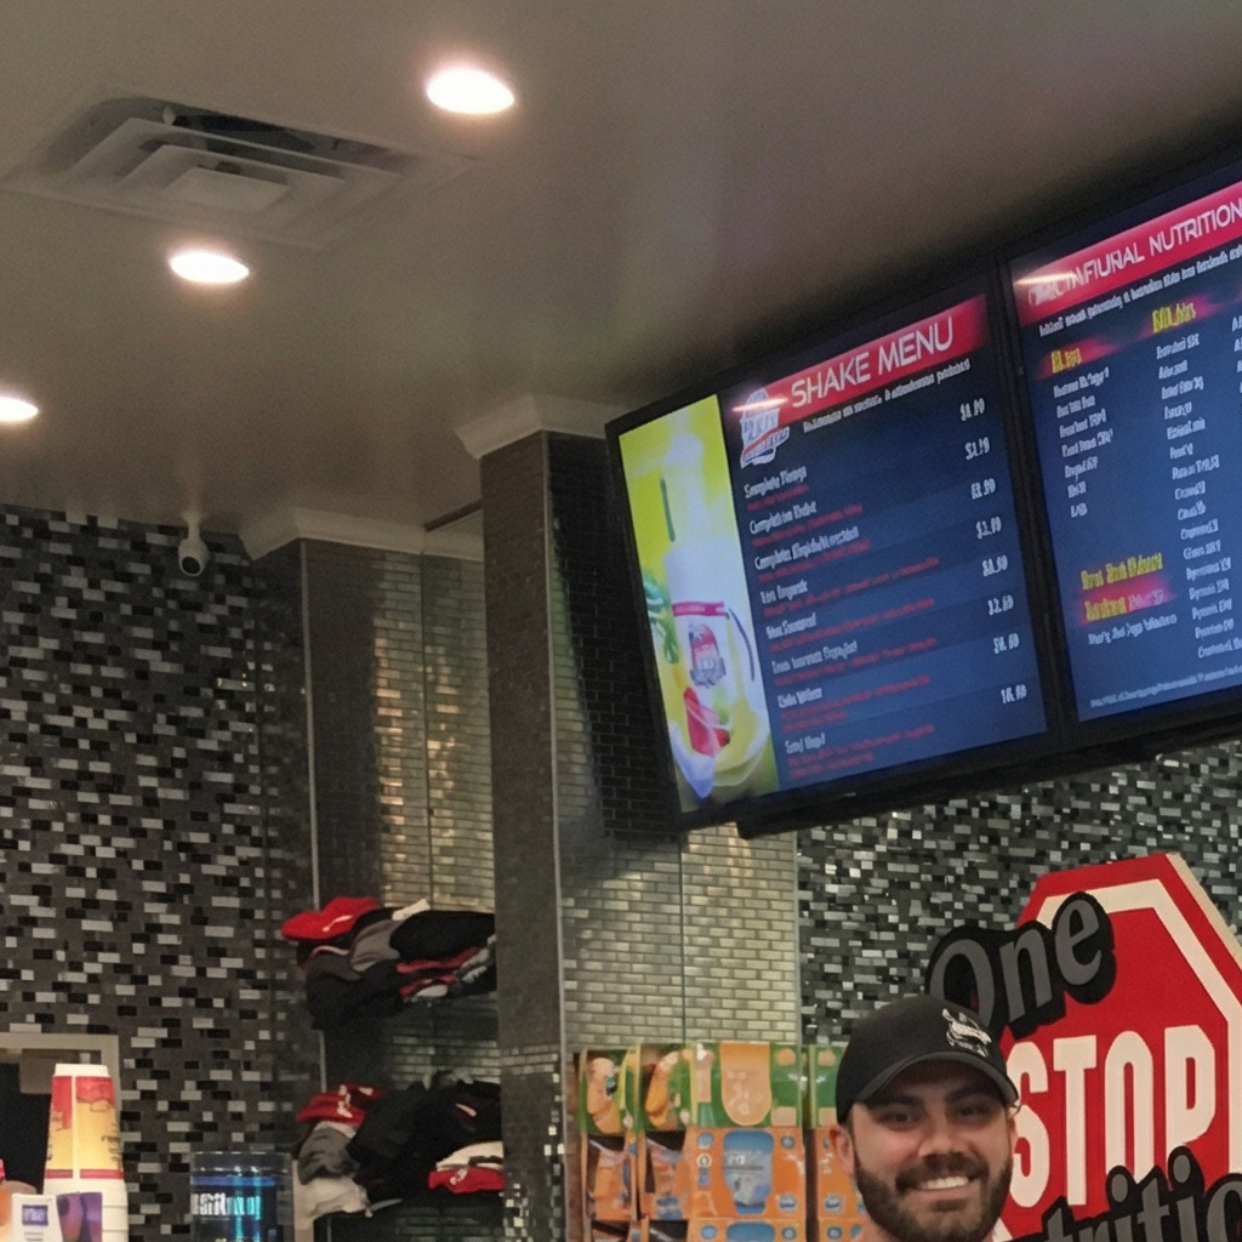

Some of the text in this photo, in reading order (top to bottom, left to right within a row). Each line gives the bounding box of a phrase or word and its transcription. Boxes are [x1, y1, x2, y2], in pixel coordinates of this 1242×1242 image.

[792, 316, 954, 408] SHAKE MENU
[928, 898, 1102, 1027] One
[1006, 1024, 1216, 1208] STOP
